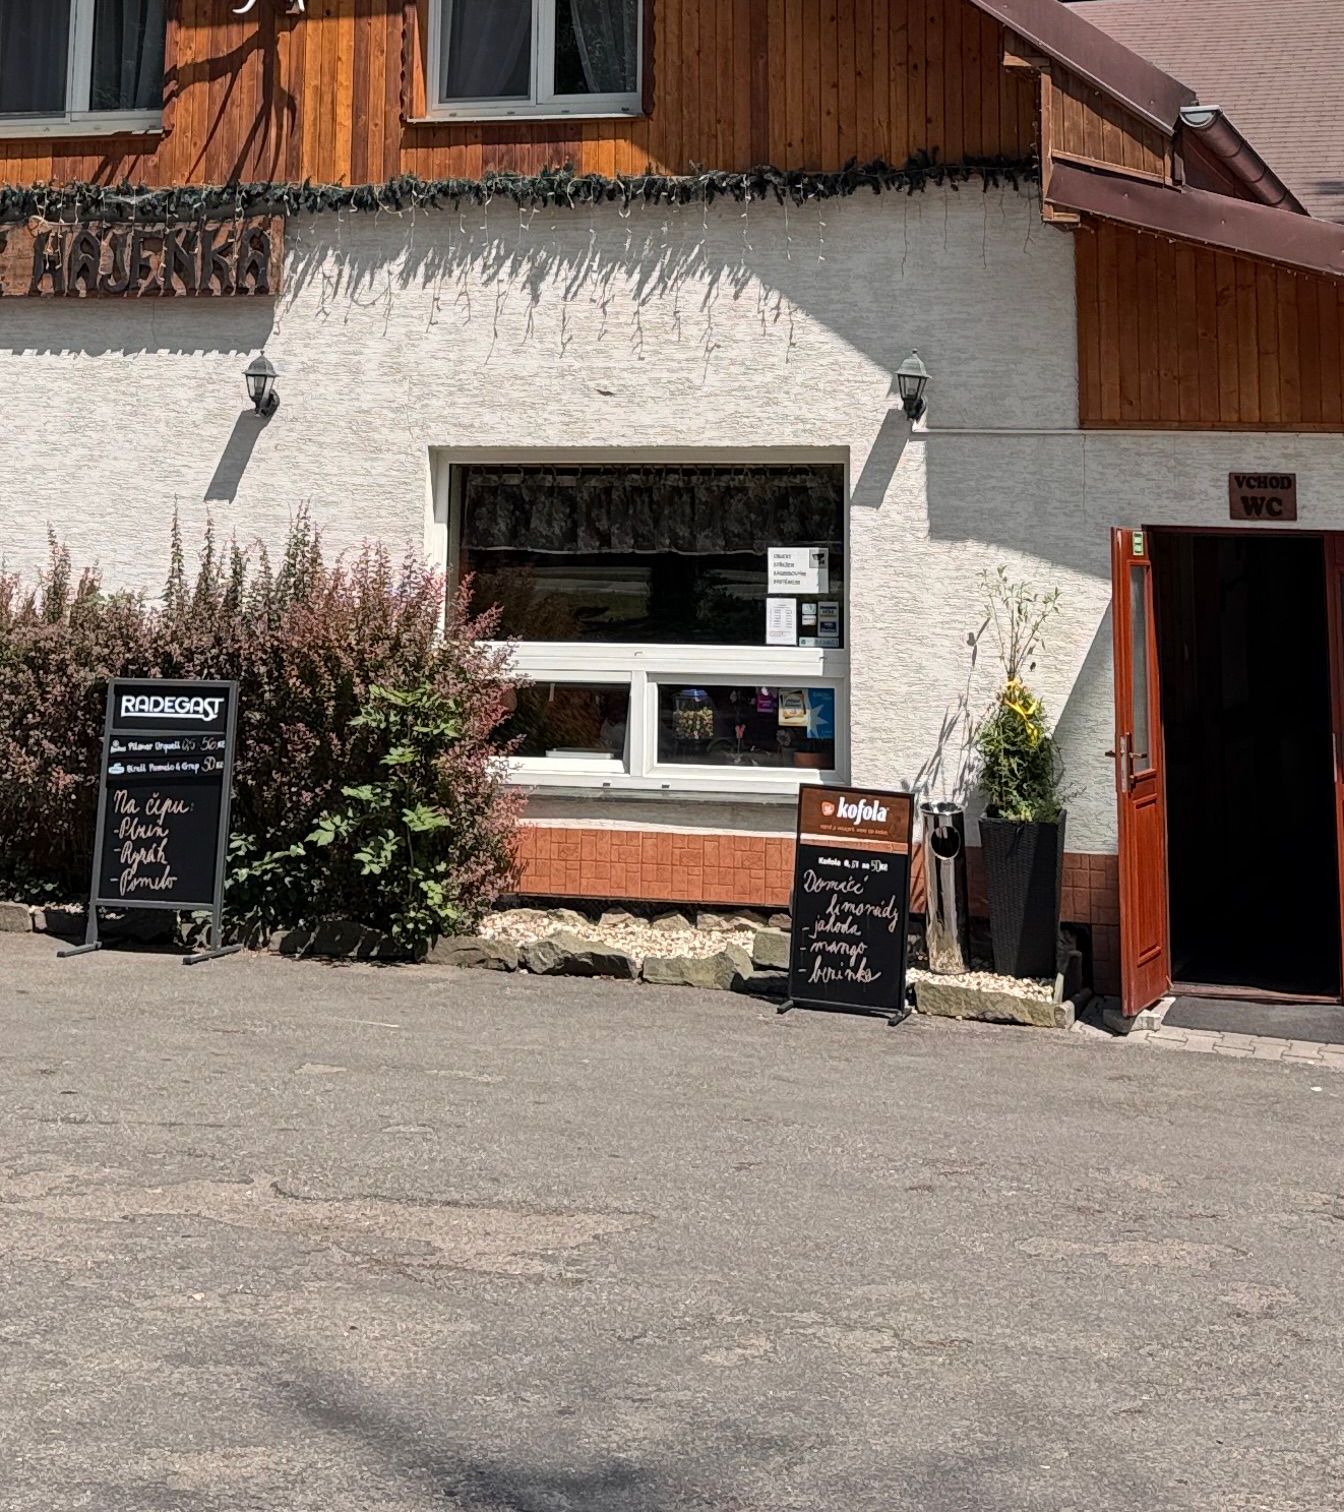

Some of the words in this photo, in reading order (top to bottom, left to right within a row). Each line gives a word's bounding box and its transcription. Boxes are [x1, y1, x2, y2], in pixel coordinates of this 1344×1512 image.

[1234, 475, 1293, 490] VCHOD
[1240, 495, 1283, 517] WC
[120, 695, 225, 721] RADEGAST
[113, 789, 141, 815] Na
[836, 796, 888, 825] kofola
